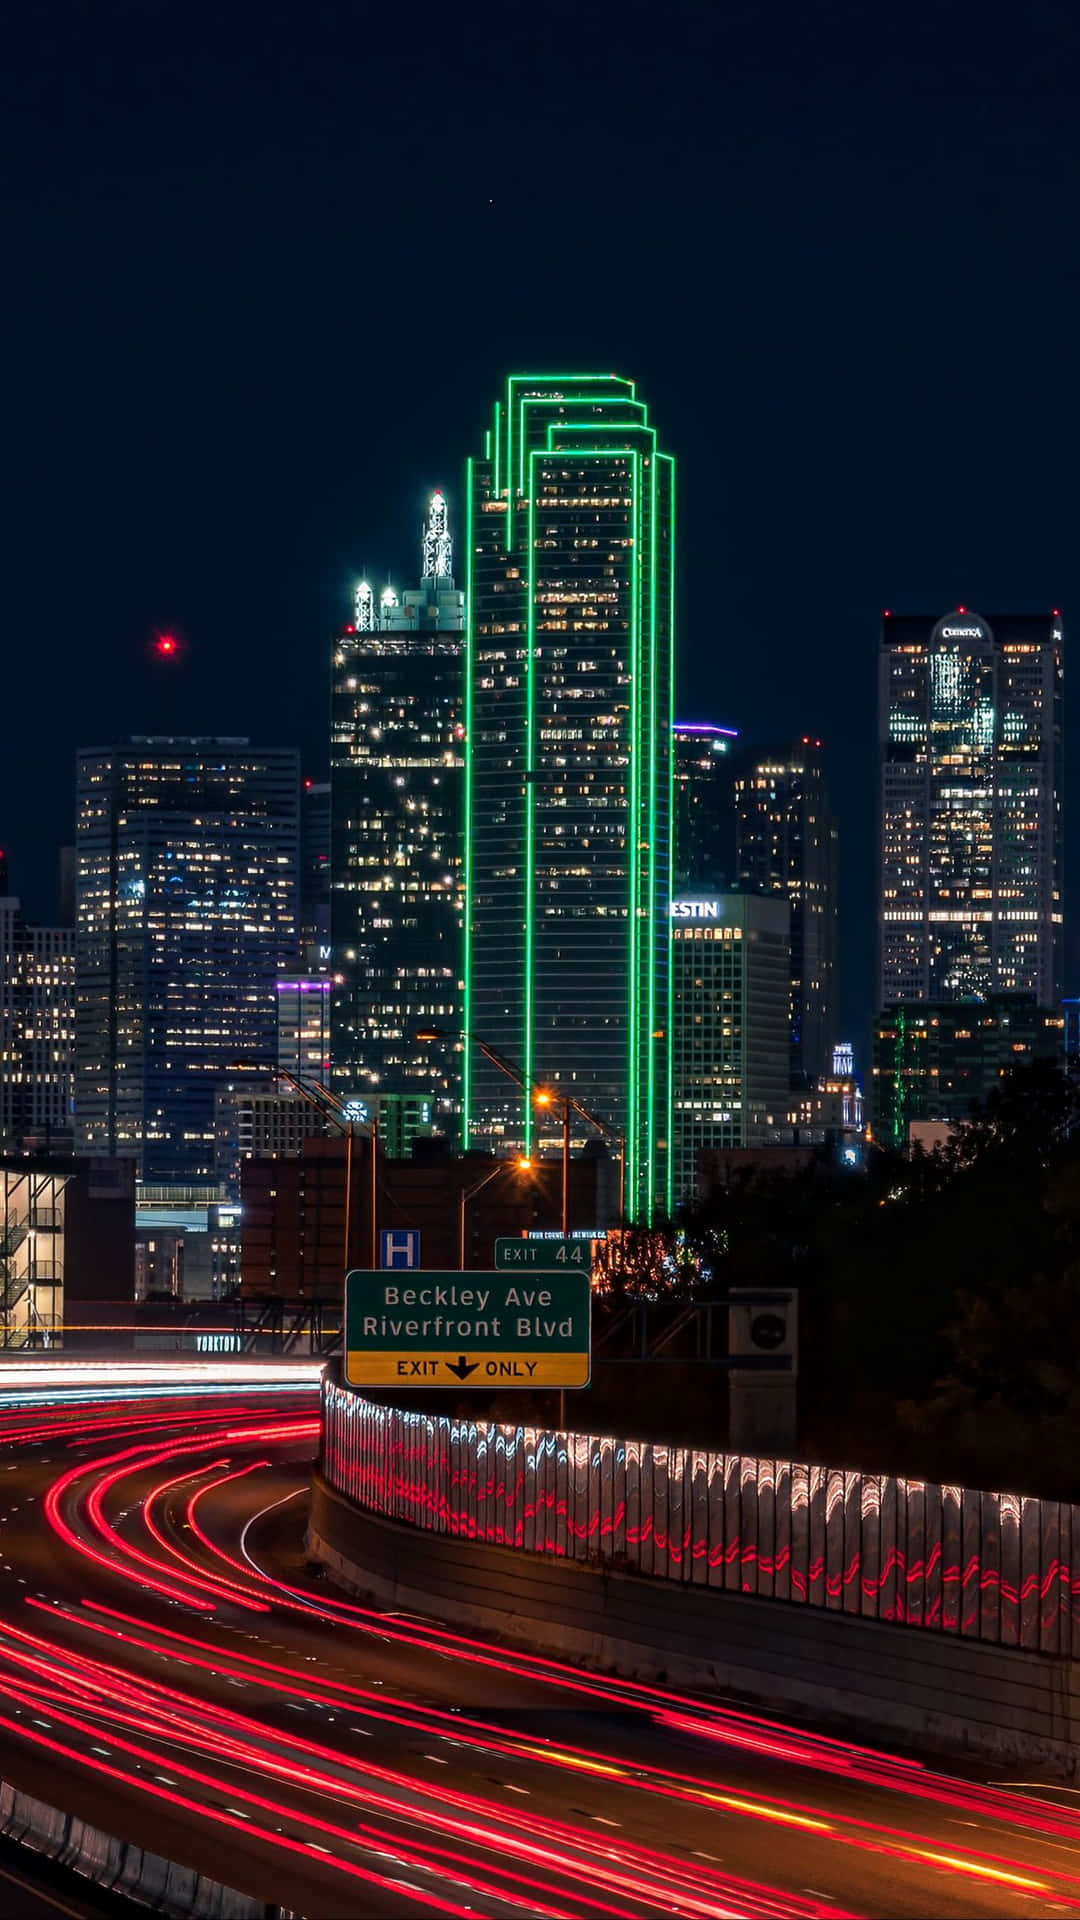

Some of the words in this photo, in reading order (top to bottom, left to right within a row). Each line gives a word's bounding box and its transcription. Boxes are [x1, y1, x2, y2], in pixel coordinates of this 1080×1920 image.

[669, 902, 718, 917] ESTIN
[386, 1232, 414, 1267] H
[503, 1248, 537, 1261] EXIT
[555, 1245, 583, 1263] 44
[384, 1286, 490, 1311] Beckley
[505, 1287, 552, 1306] Ave
[363, 1316, 501, 1337] Riverfront
[517, 1317, 574, 1337] Blvd
[397, 1361, 439, 1376] EXIT
[485, 1361, 538, 1377] ONLY
